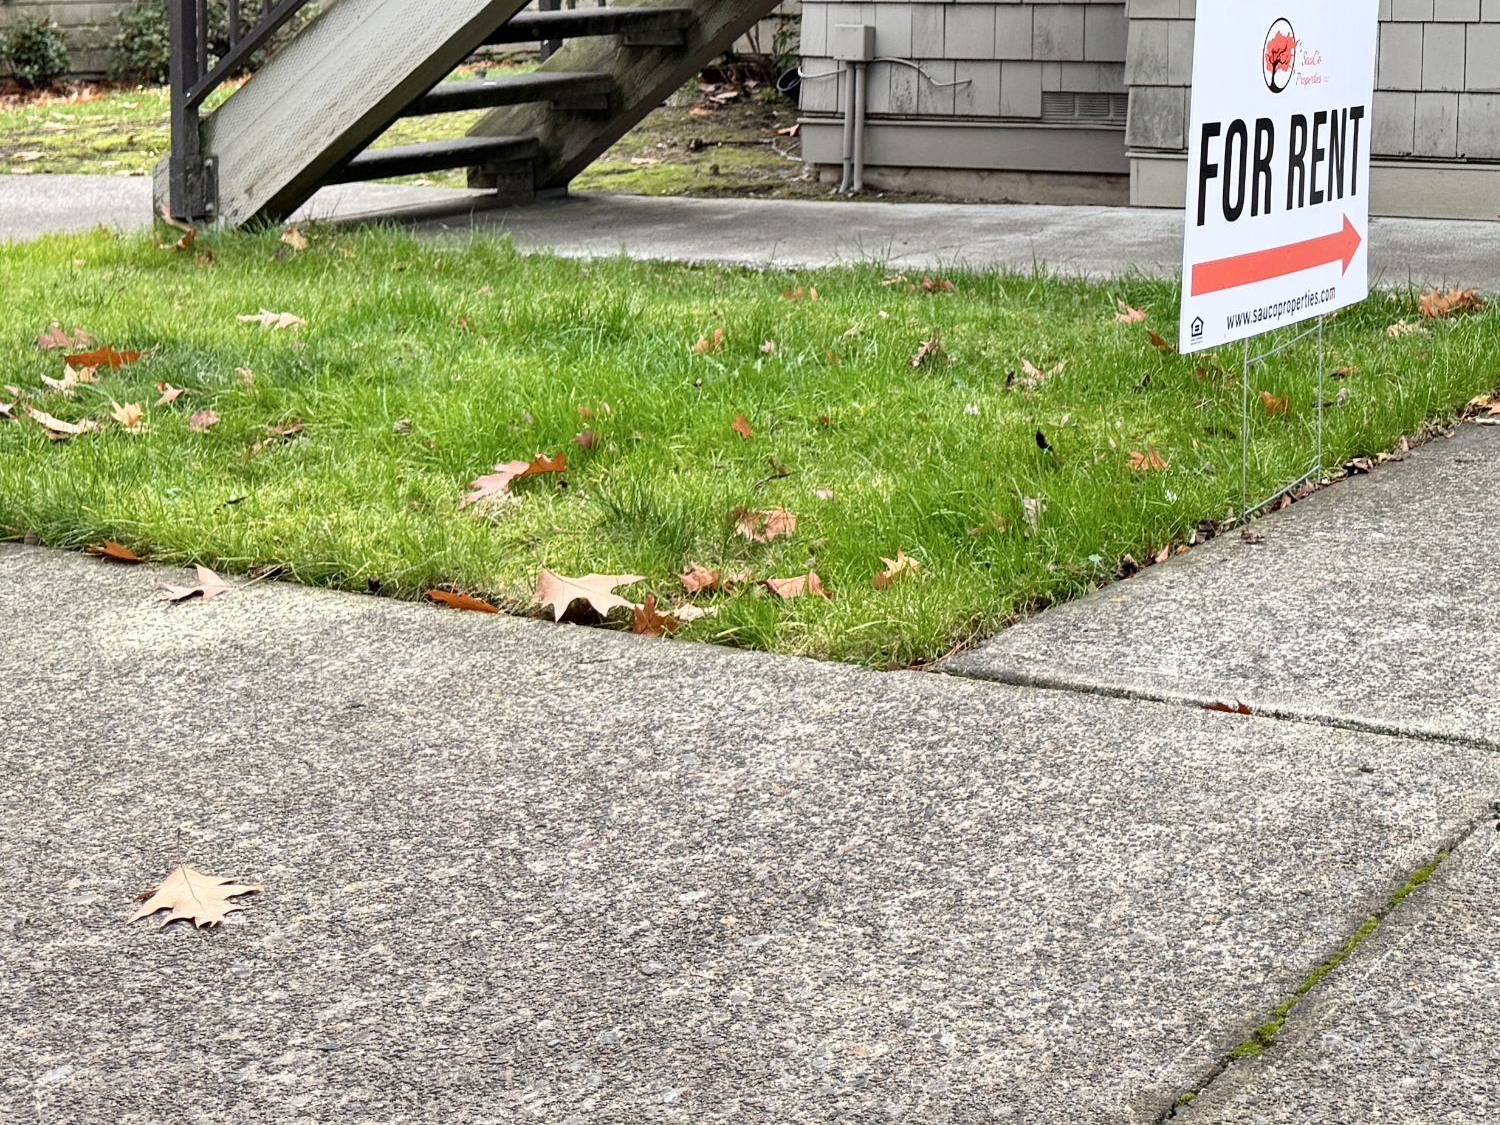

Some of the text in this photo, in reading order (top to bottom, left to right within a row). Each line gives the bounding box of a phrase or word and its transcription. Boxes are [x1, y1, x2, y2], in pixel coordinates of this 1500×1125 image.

[1197, 105, 1365, 226] FOR RENT
[1226, 286, 1336, 330] www.saucoproperties.com
